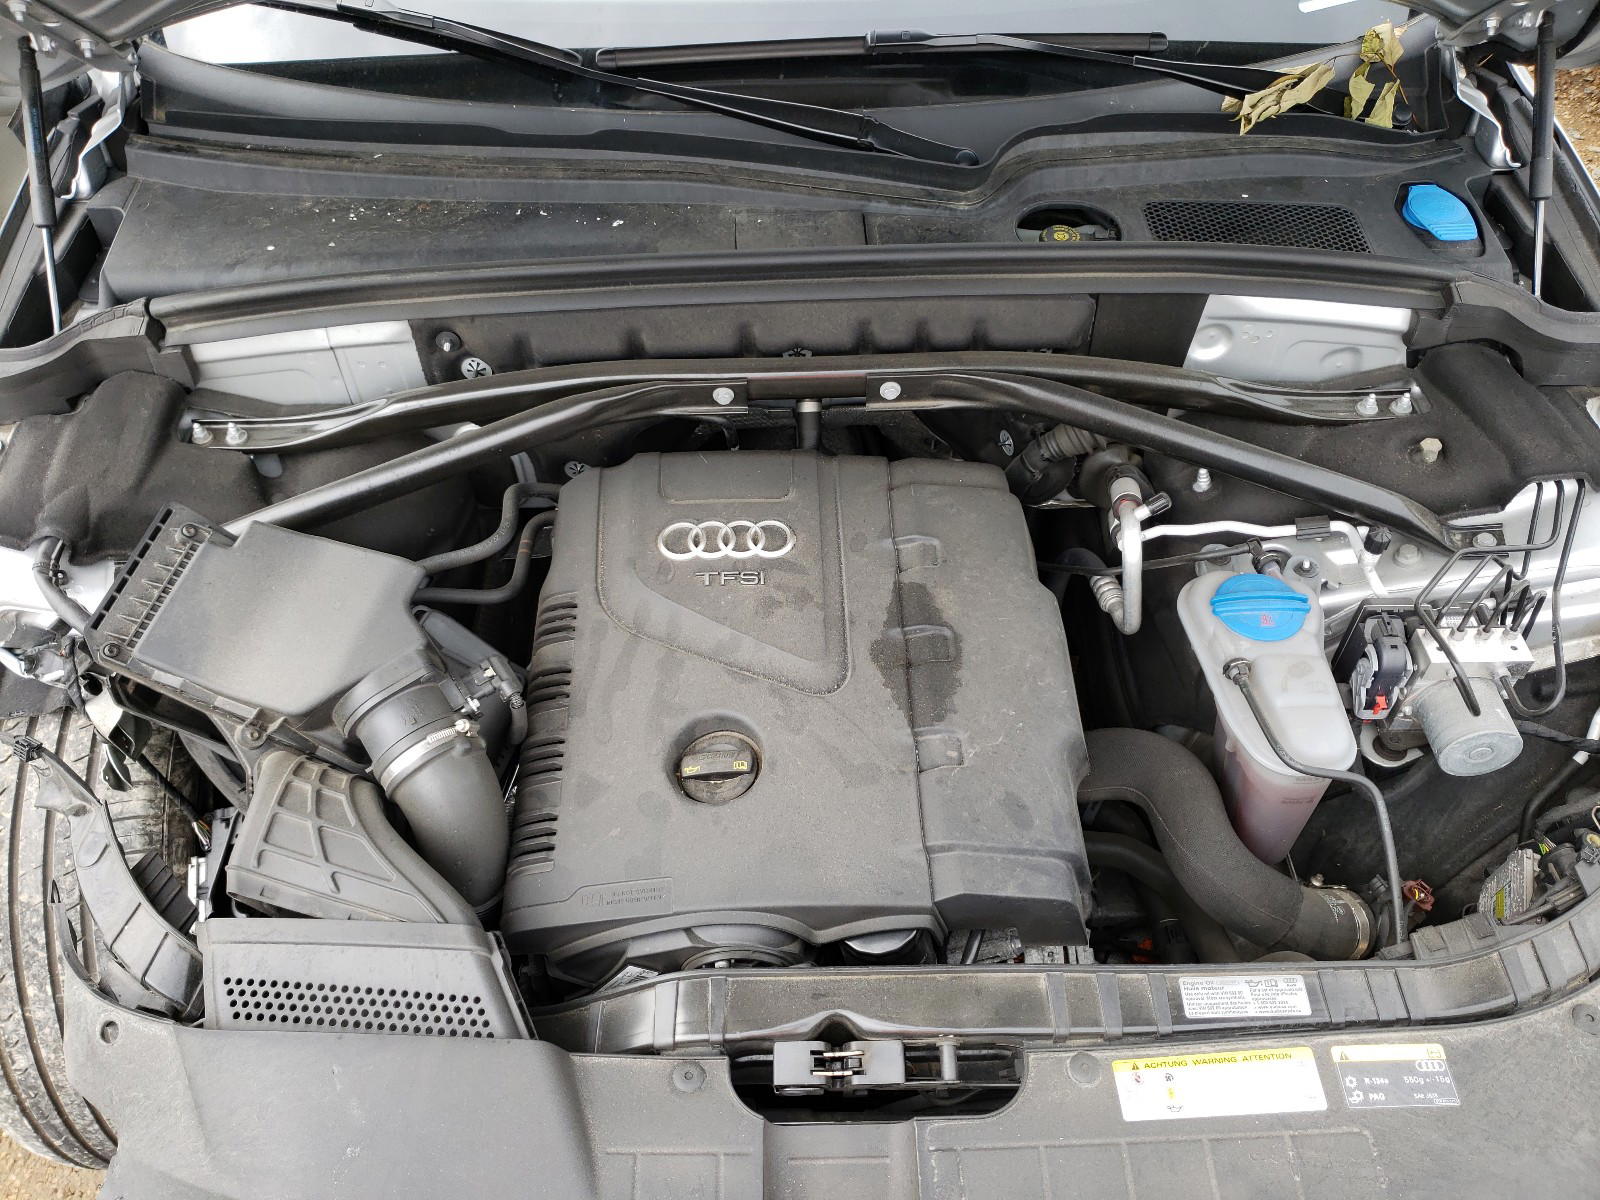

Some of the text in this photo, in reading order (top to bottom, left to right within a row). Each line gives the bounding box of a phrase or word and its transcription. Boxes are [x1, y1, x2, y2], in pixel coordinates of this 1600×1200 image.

[695, 570, 765, 586] TFSI
[1144, 1053, 1292, 1069] ACHTUNG WARNING ATTENTION
